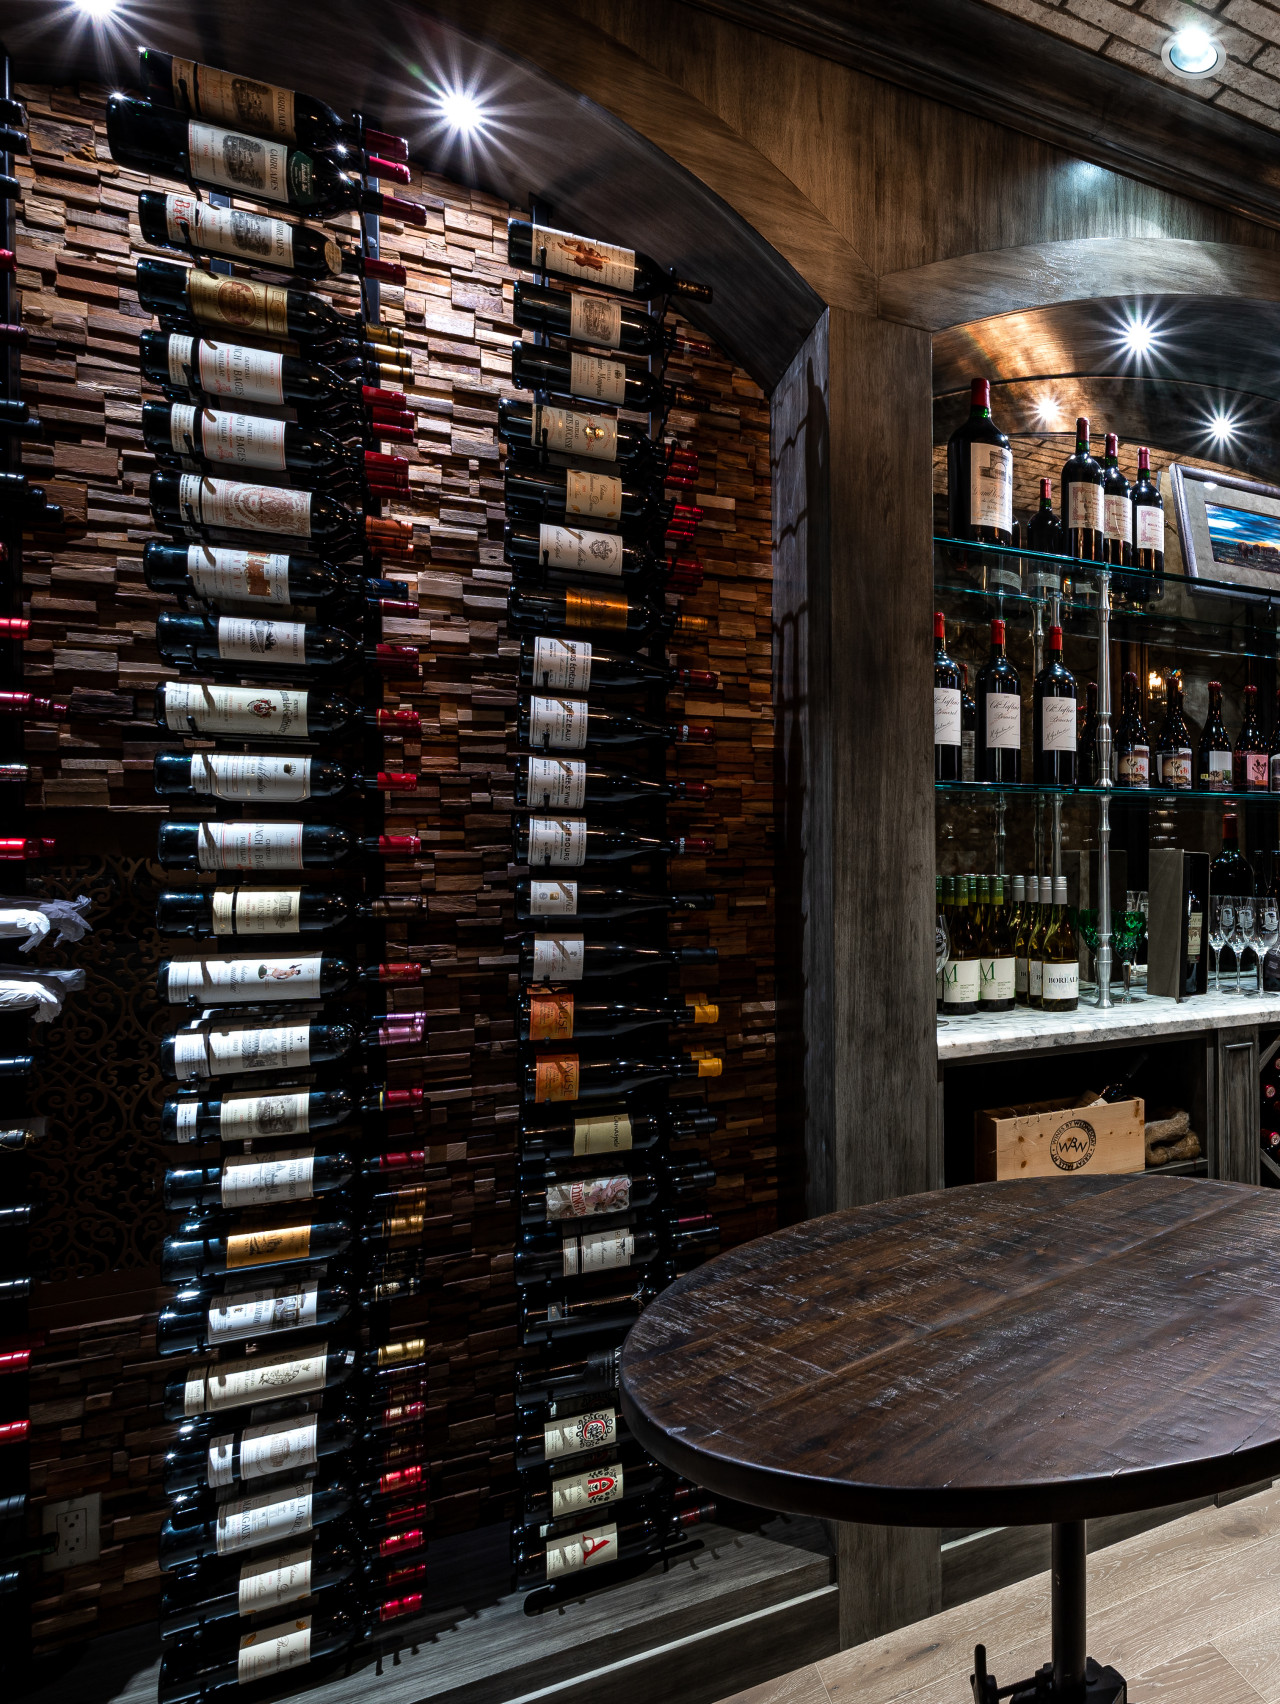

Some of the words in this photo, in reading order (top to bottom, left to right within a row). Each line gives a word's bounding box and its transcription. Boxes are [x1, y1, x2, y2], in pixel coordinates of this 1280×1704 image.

[270, 148, 279, 191] CARRUADES
[565, 701, 574, 742] ÉCHÉZEAUX
[241, 1499, 252, 1541] MARGAUX
